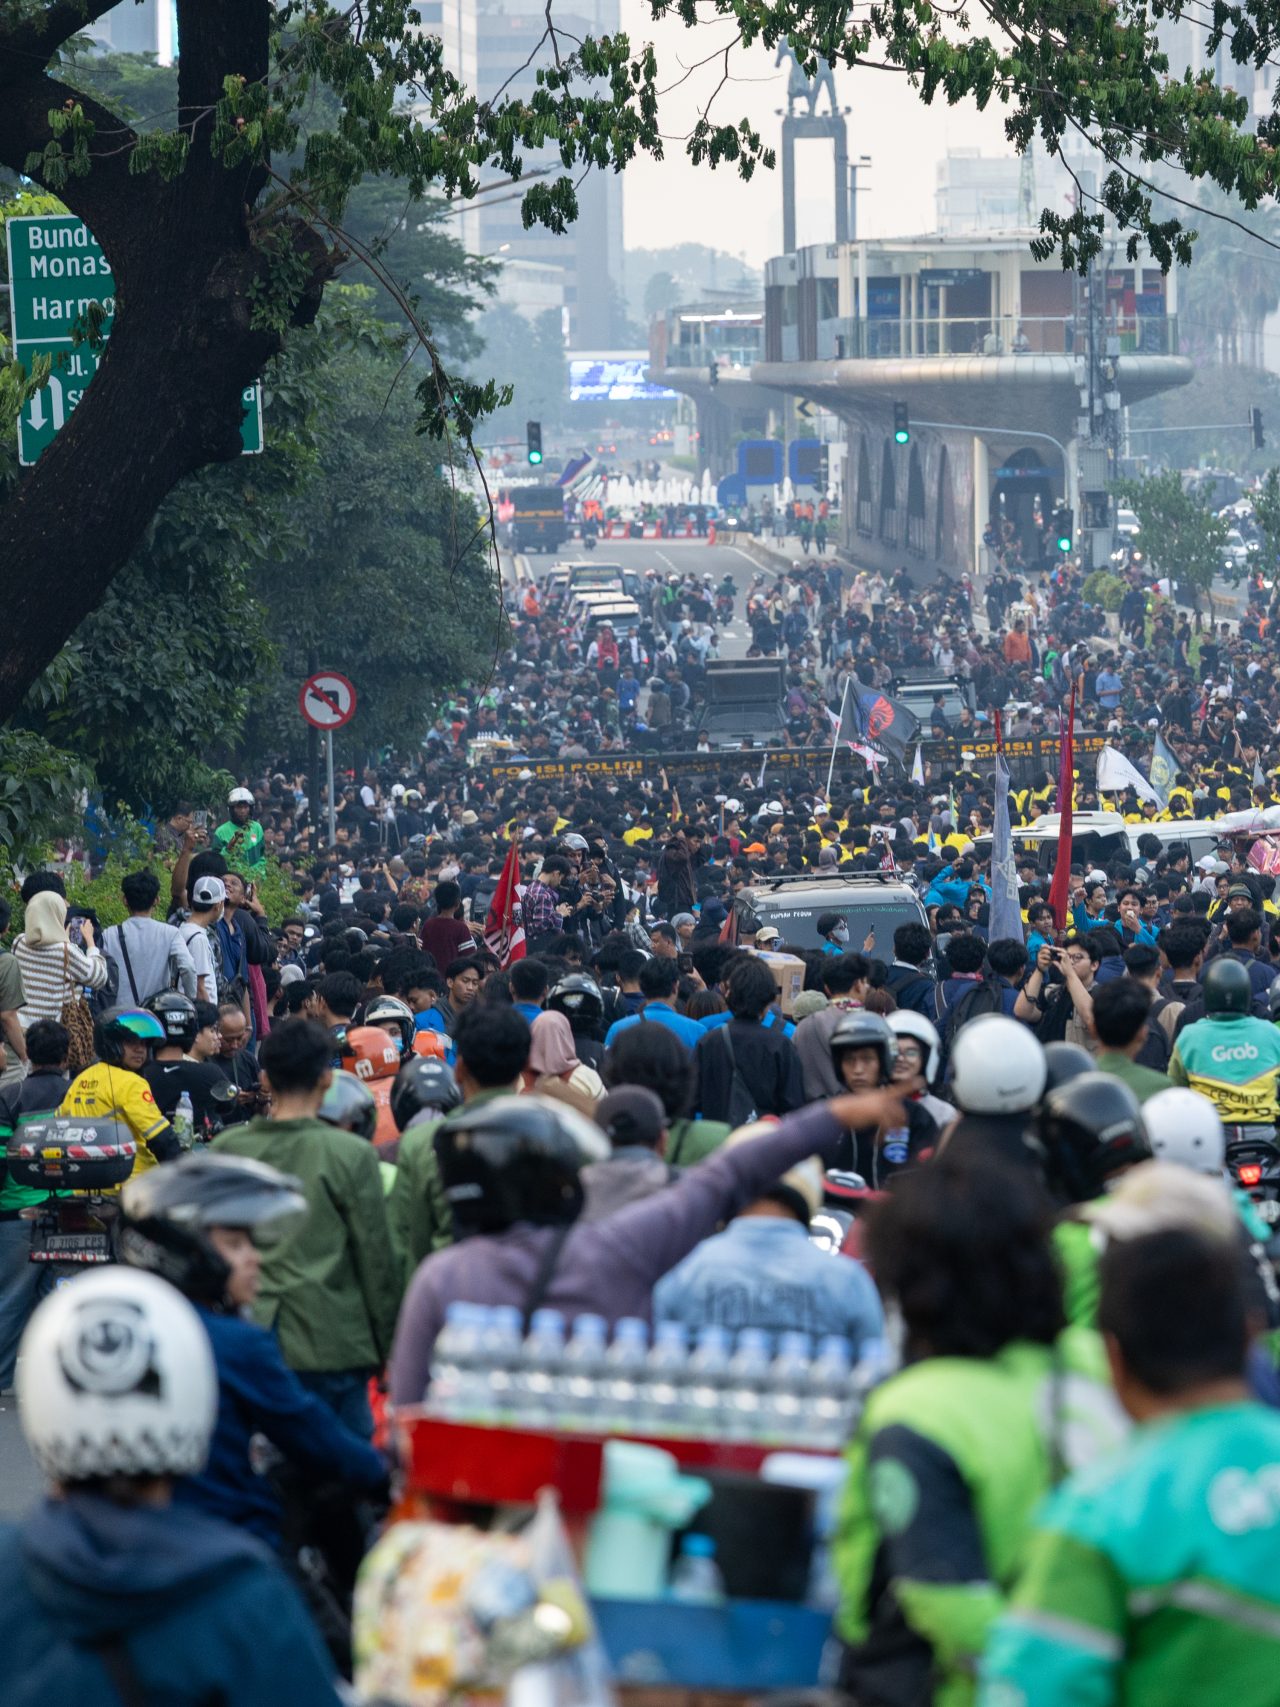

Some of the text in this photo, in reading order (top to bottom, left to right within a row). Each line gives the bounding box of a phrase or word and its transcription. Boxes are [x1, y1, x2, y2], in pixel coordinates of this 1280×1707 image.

[30, 254, 112, 278] Monas
[67, 354, 89, 377] Jl.
[1211, 1042, 1259, 1063] Grab
